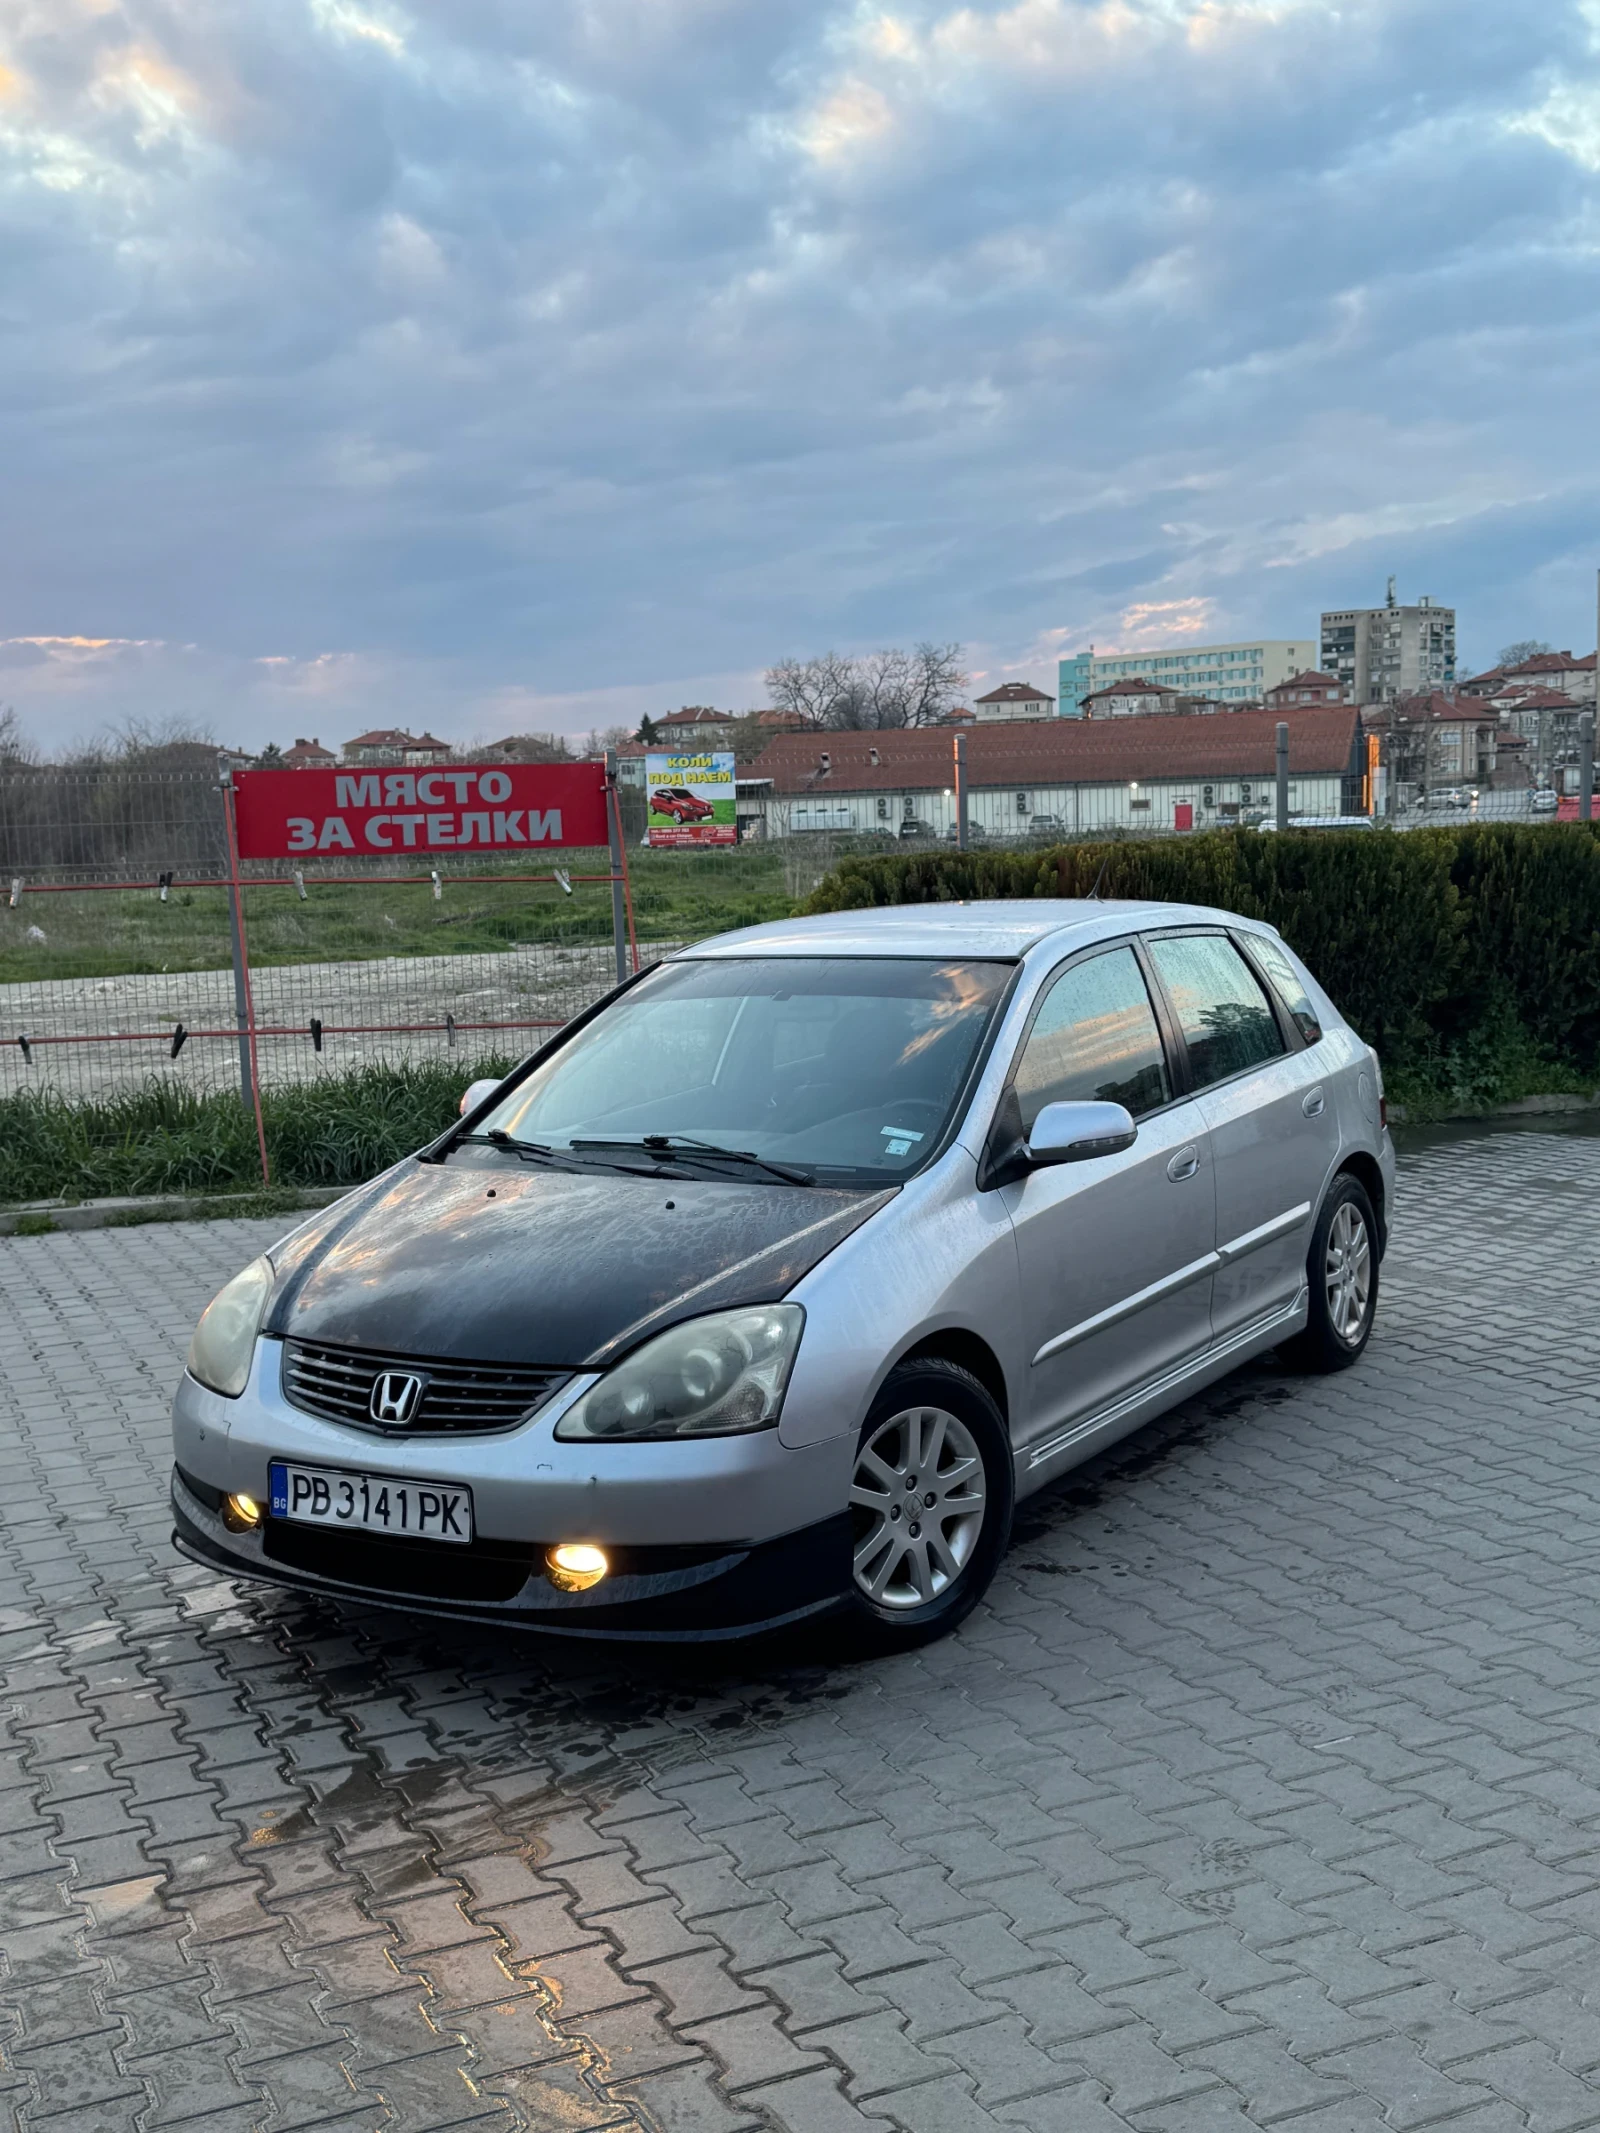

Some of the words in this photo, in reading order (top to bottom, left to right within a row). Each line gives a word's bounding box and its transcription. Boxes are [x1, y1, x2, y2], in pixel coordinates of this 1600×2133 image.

[667, 757, 713, 768] КОЛИ
[649, 773, 684, 786] ПОД
[686, 771, 732, 783] НАЕМ
[335, 771, 513, 808] МЯСТО
[286, 816, 356, 851] ЗА
[364, 809, 563, 847] СТЕЛКИ
[273, 1497, 287, 1509] BG
